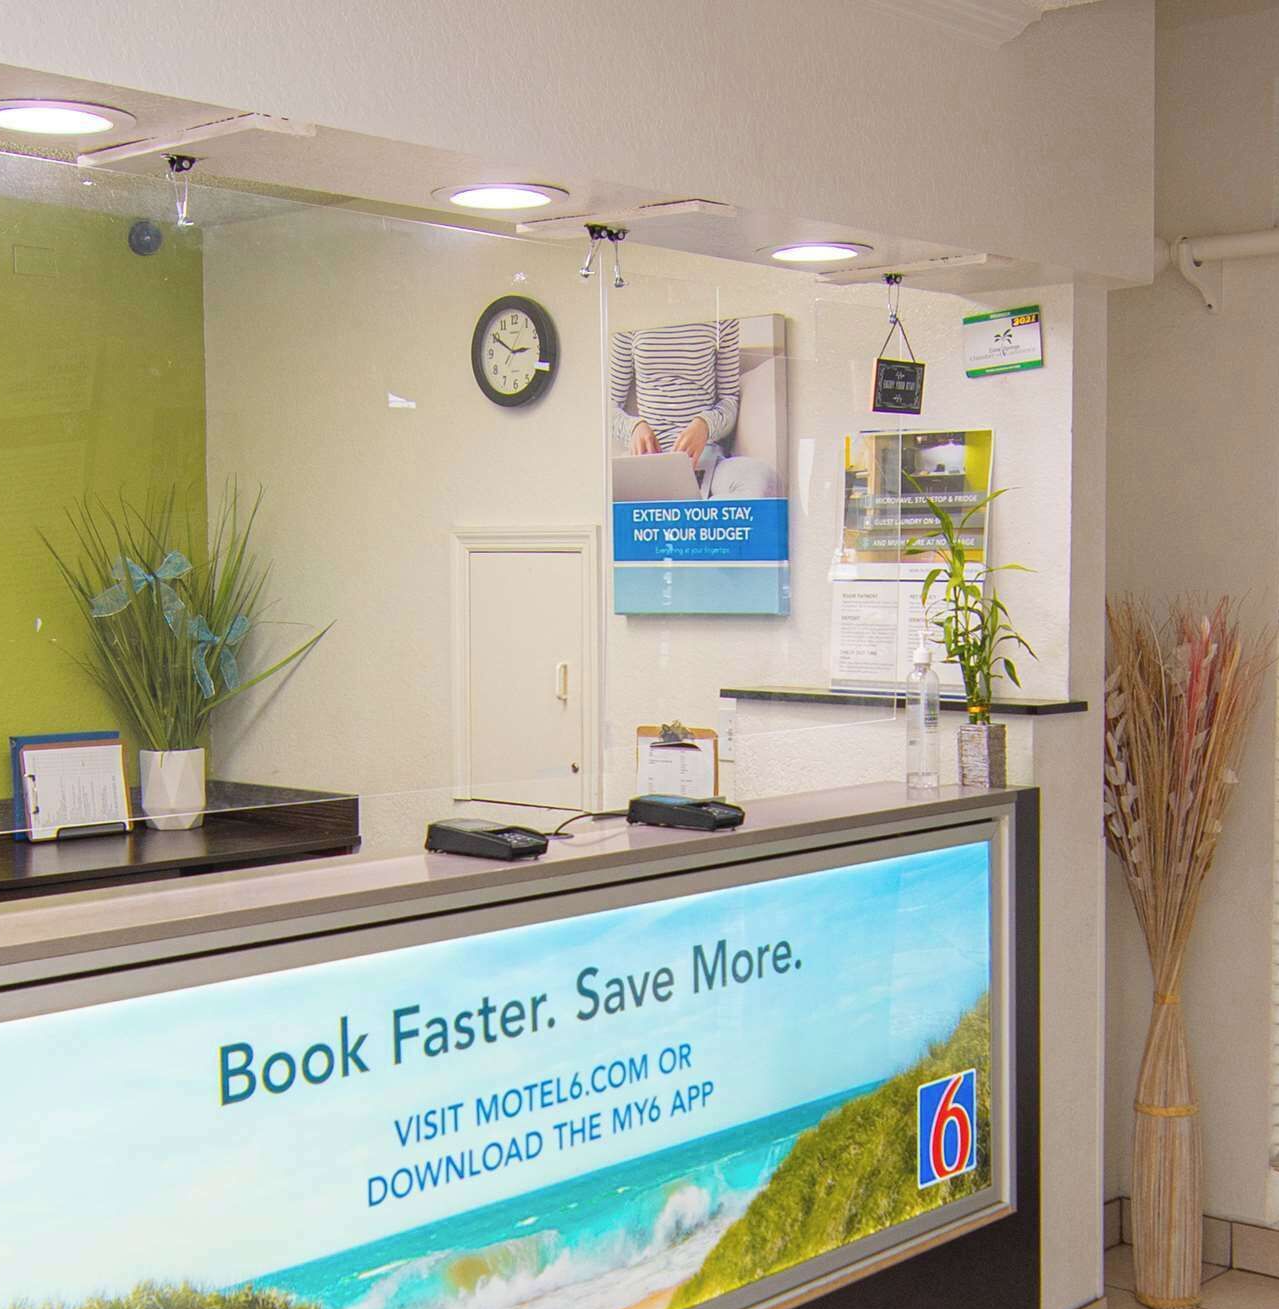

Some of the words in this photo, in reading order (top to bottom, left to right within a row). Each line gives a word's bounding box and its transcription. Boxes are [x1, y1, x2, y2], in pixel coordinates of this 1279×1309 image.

[633, 508, 681, 522] EXTEND
[684, 508, 718, 521] YOUR
[722, 507, 753, 522] STAY,
[634, 529, 660, 541] NOT
[663, 528, 696, 541] YOUR
[700, 527, 751, 541] BUDGET
[220, 1016, 370, 1106] Book
[393, 996, 555, 1065] Faster.
[576, 966, 674, 1021] Save
[692, 939, 802, 994] More.
[368, 1131, 543, 1207] DOWNLOAD
[553, 1113, 601, 1150] THE
[612, 1096, 661, 1134] MY6
[670, 1081, 714, 1116] APP
[394, 1102, 464, 1147] VISIT
[476, 1054, 648, 1126] MOTEL6.COM
[659, 1043, 692, 1075] OR
[929, 1072, 972, 1180] 6
